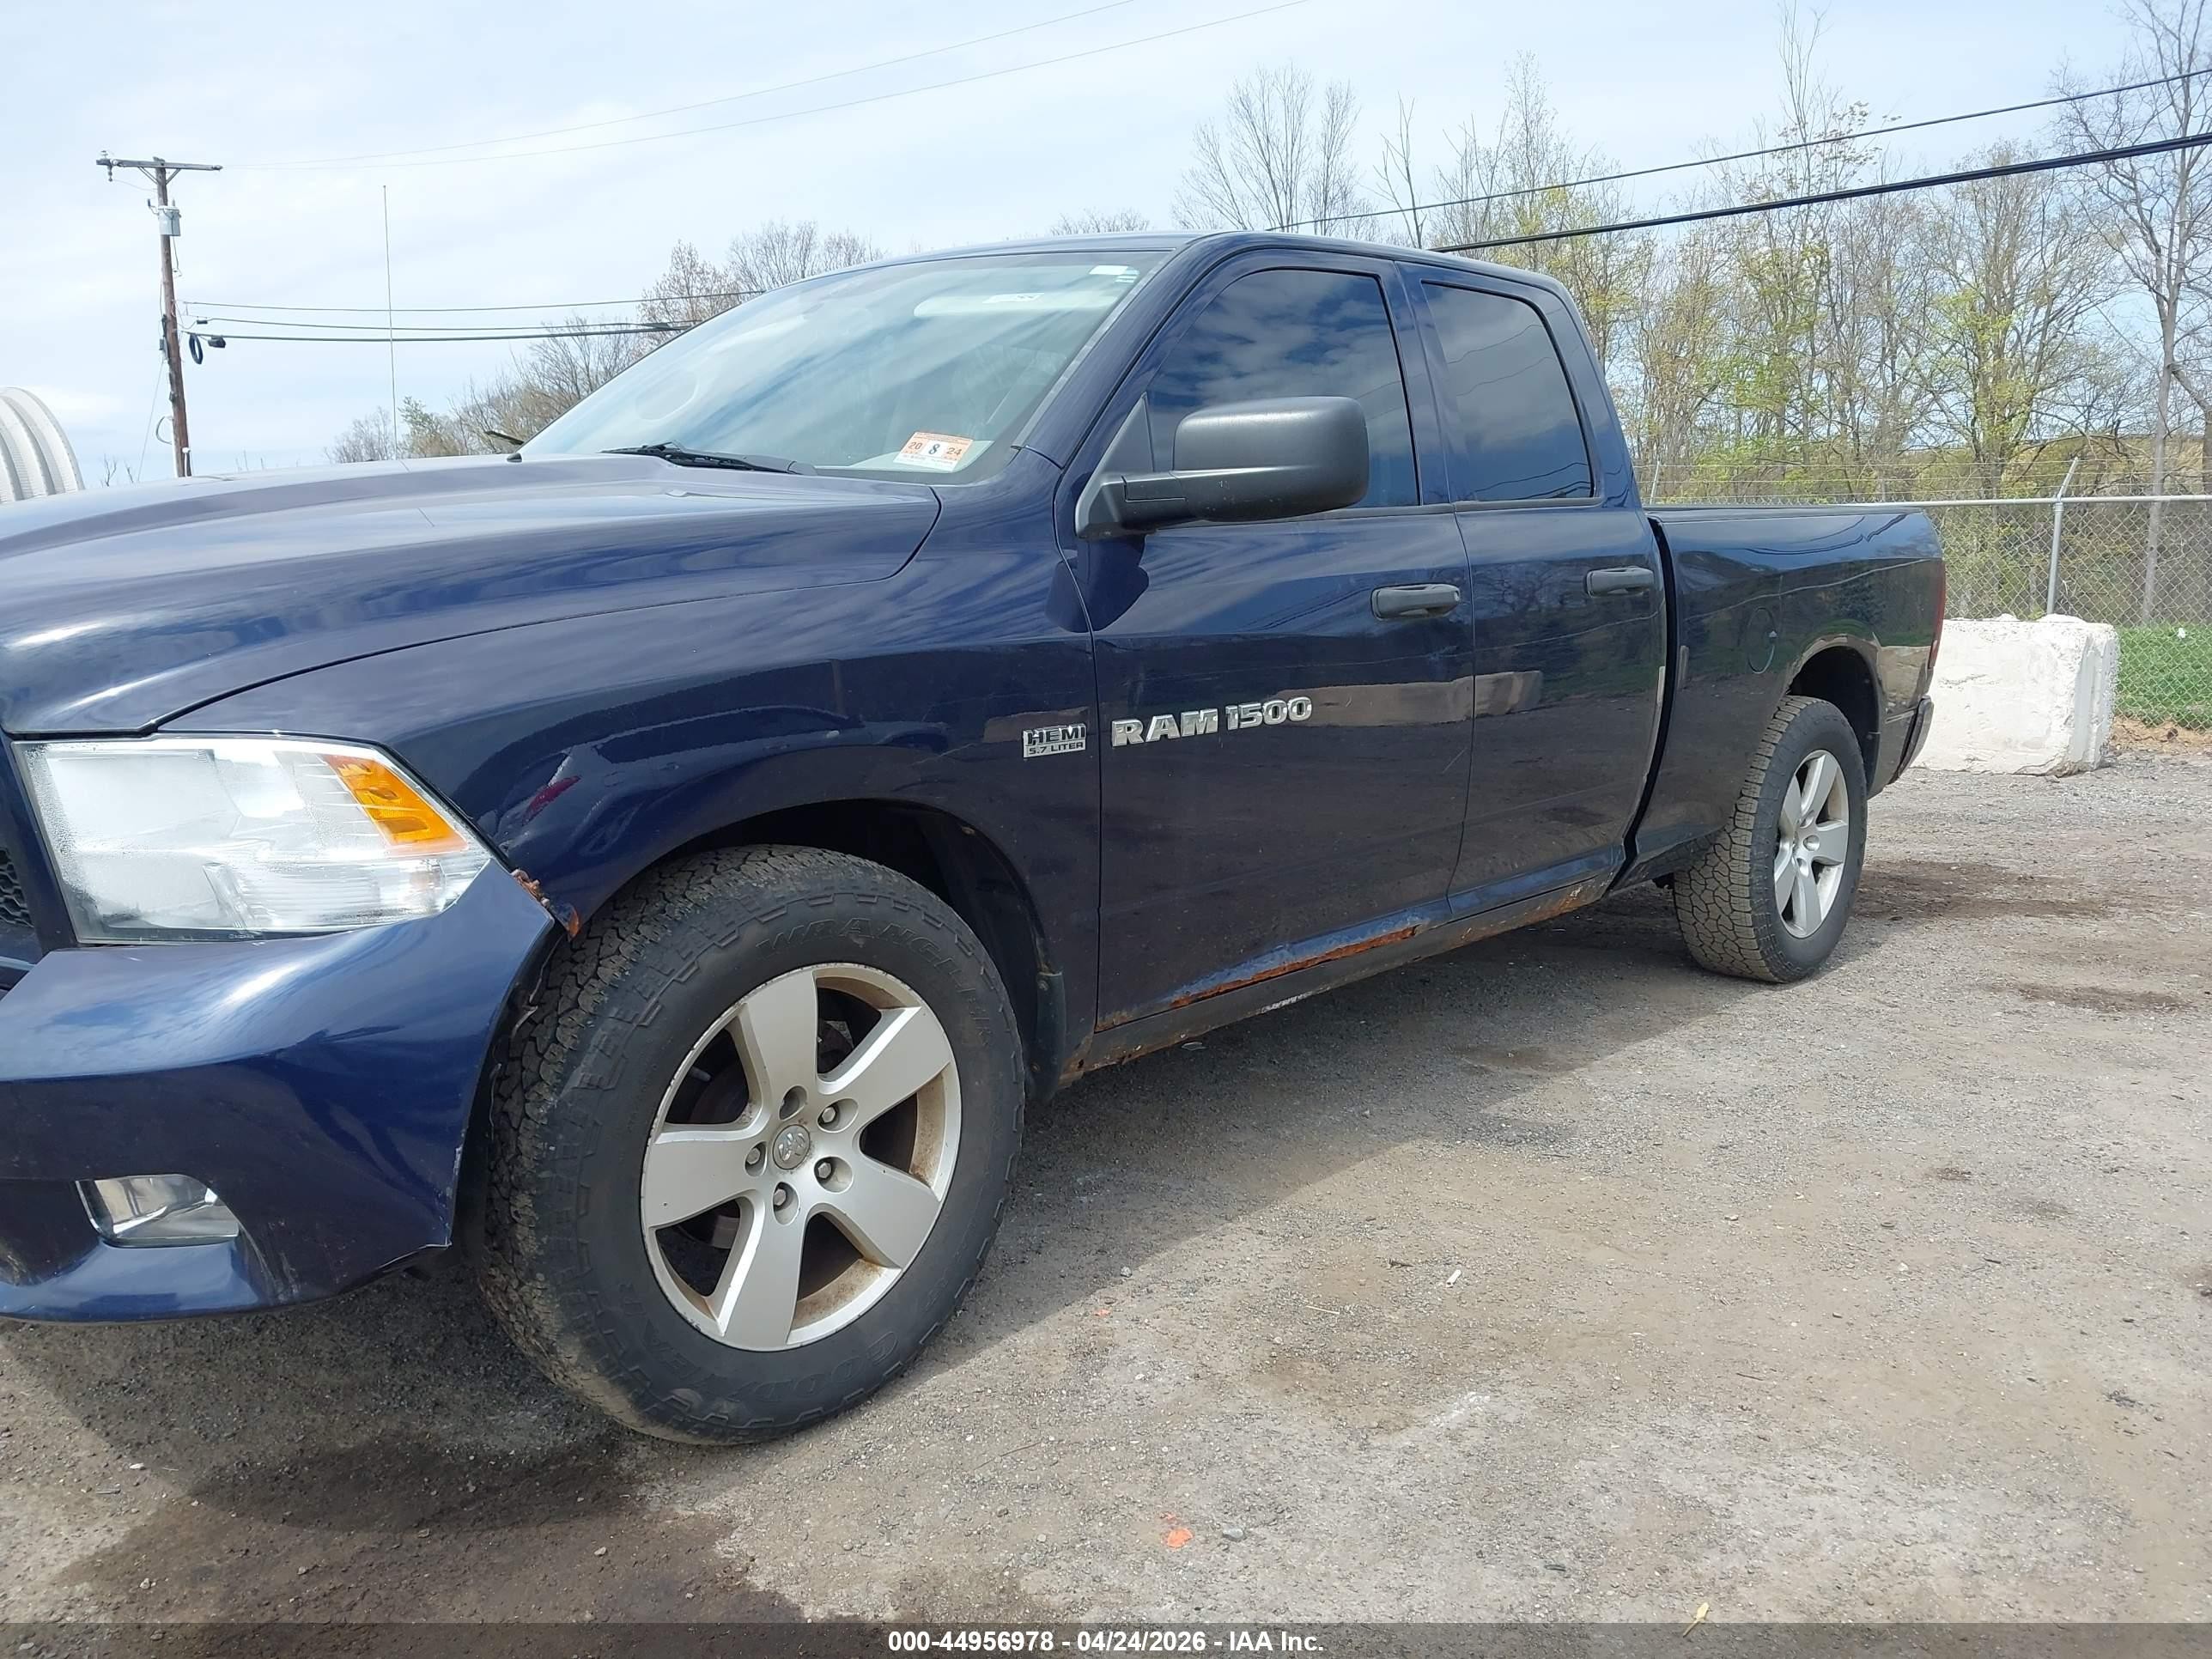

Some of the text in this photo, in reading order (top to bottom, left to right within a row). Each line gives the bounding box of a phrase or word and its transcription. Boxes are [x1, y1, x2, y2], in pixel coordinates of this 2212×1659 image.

[908, 441, 963, 456] 20 8 24
[1112, 696, 1313, 747] RAM 1500
[1026, 724, 1086, 746] HEMI
[1028, 741, 1085, 755] 5.7 LITER
